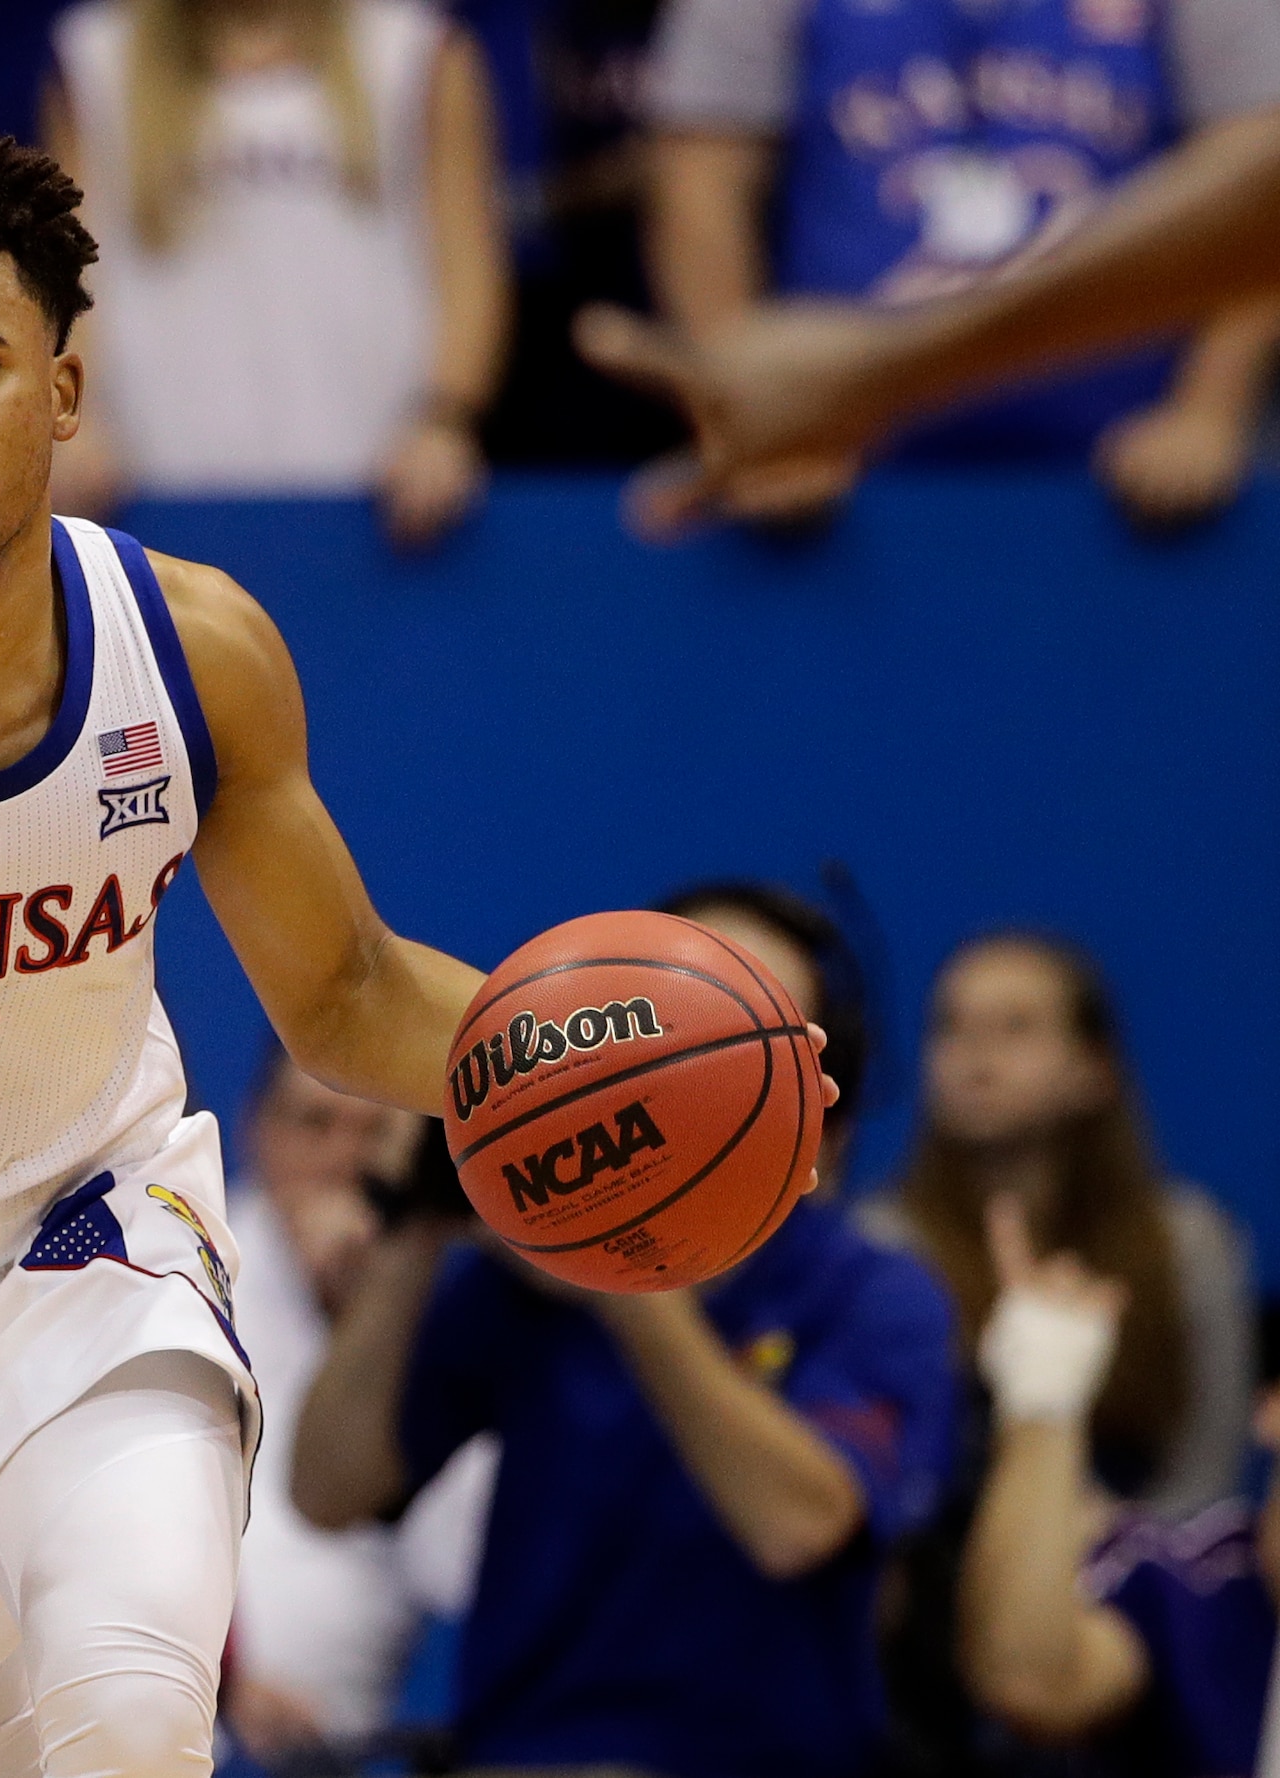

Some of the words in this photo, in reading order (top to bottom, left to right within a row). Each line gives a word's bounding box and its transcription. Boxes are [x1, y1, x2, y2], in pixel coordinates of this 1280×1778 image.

[99, 776, 171, 840] XII
[449, 996, 664, 1122] Wilson
[501, 1100, 666, 1214] NCAA
[581, 1176, 627, 1201] GAME
[629, 1154, 673, 1179] BALL
